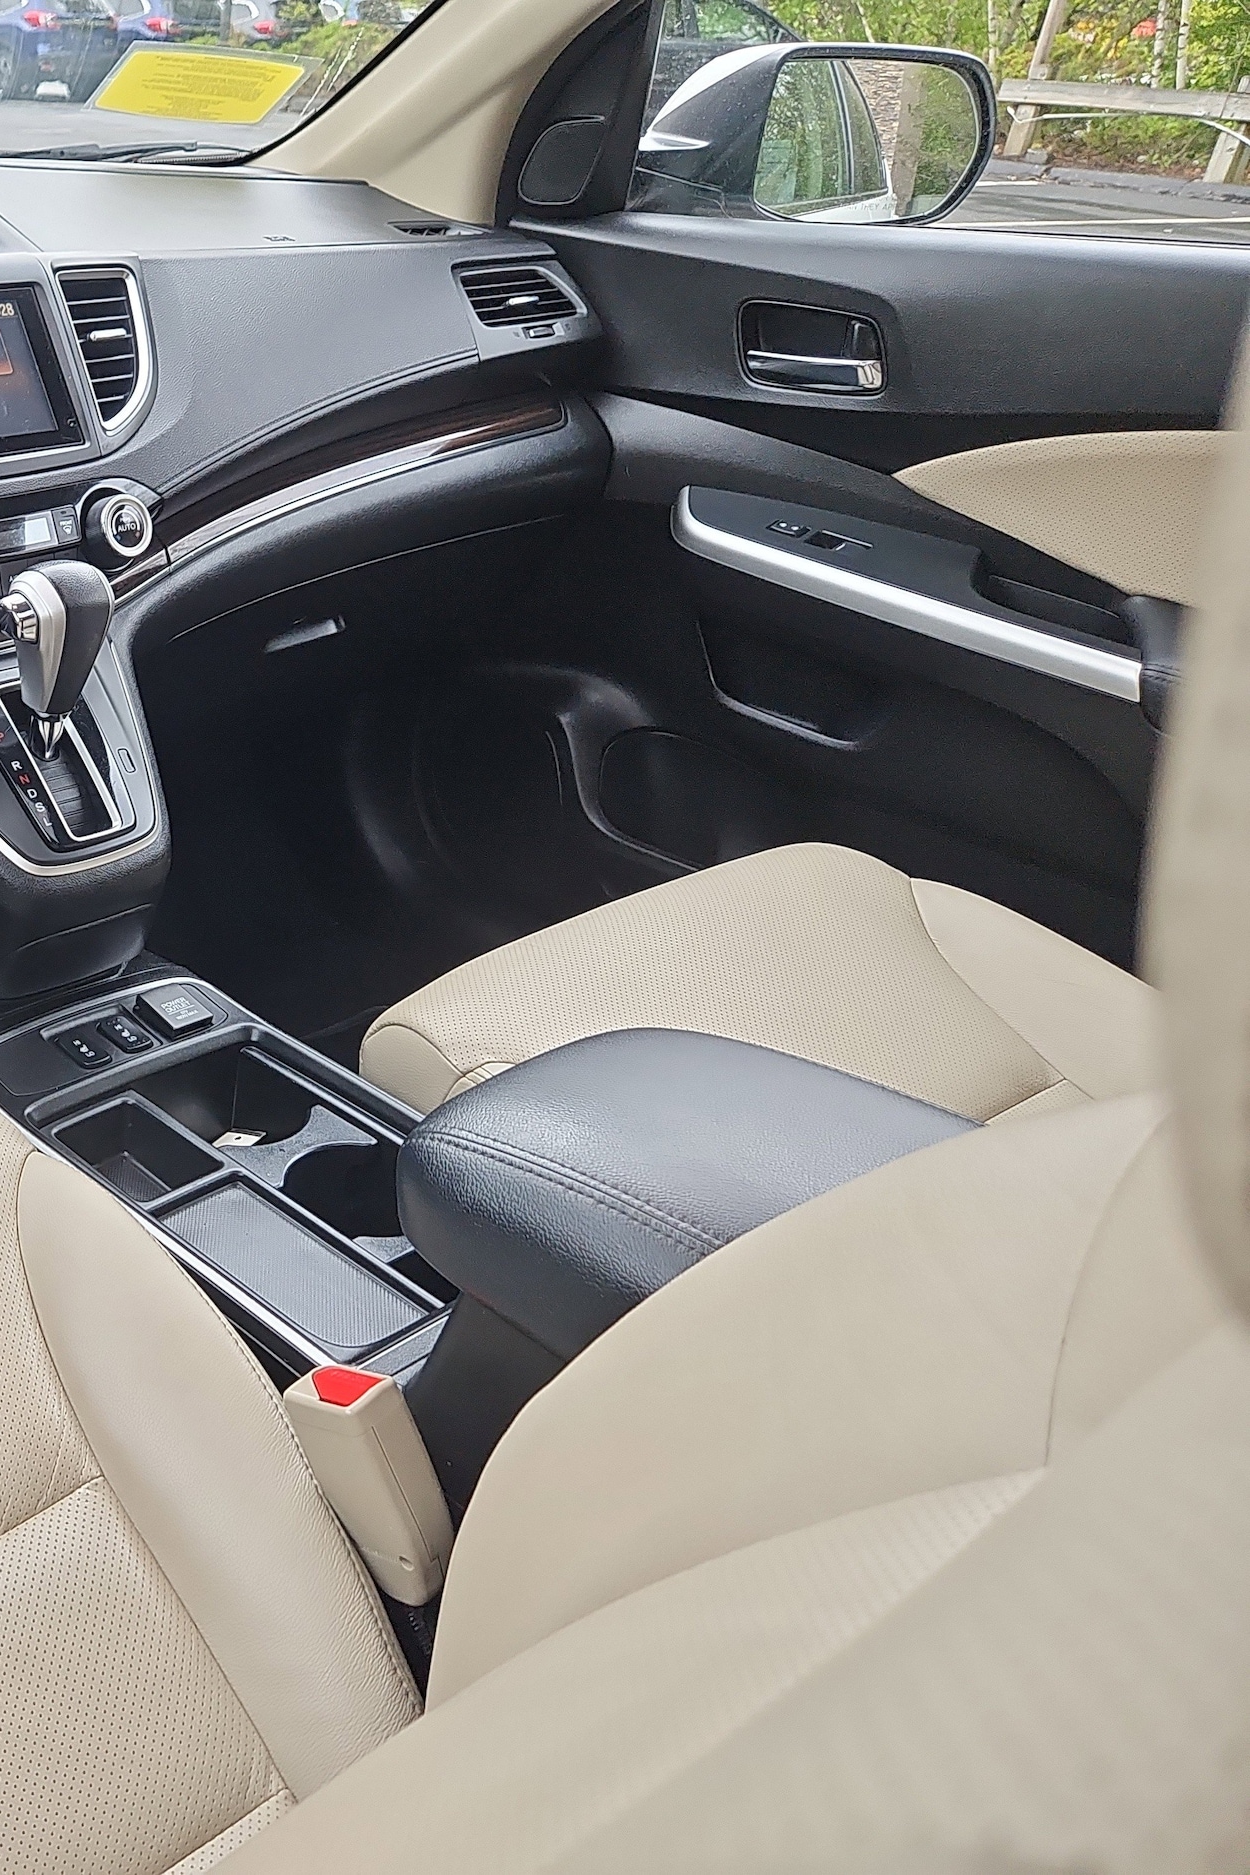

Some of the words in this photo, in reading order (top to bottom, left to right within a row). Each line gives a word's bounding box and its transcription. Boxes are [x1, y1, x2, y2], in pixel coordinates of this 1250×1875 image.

[117, 523, 136, 533] AUTO
[10, 760, 23, 771] R
[18, 774, 31, 785] N
[26, 788, 38, 799] D
[34, 802, 46, 813] S
[42, 817, 53, 827] L
[160, 996, 187, 1009] POWER
[165, 1000, 191, 1013] OUTLET
